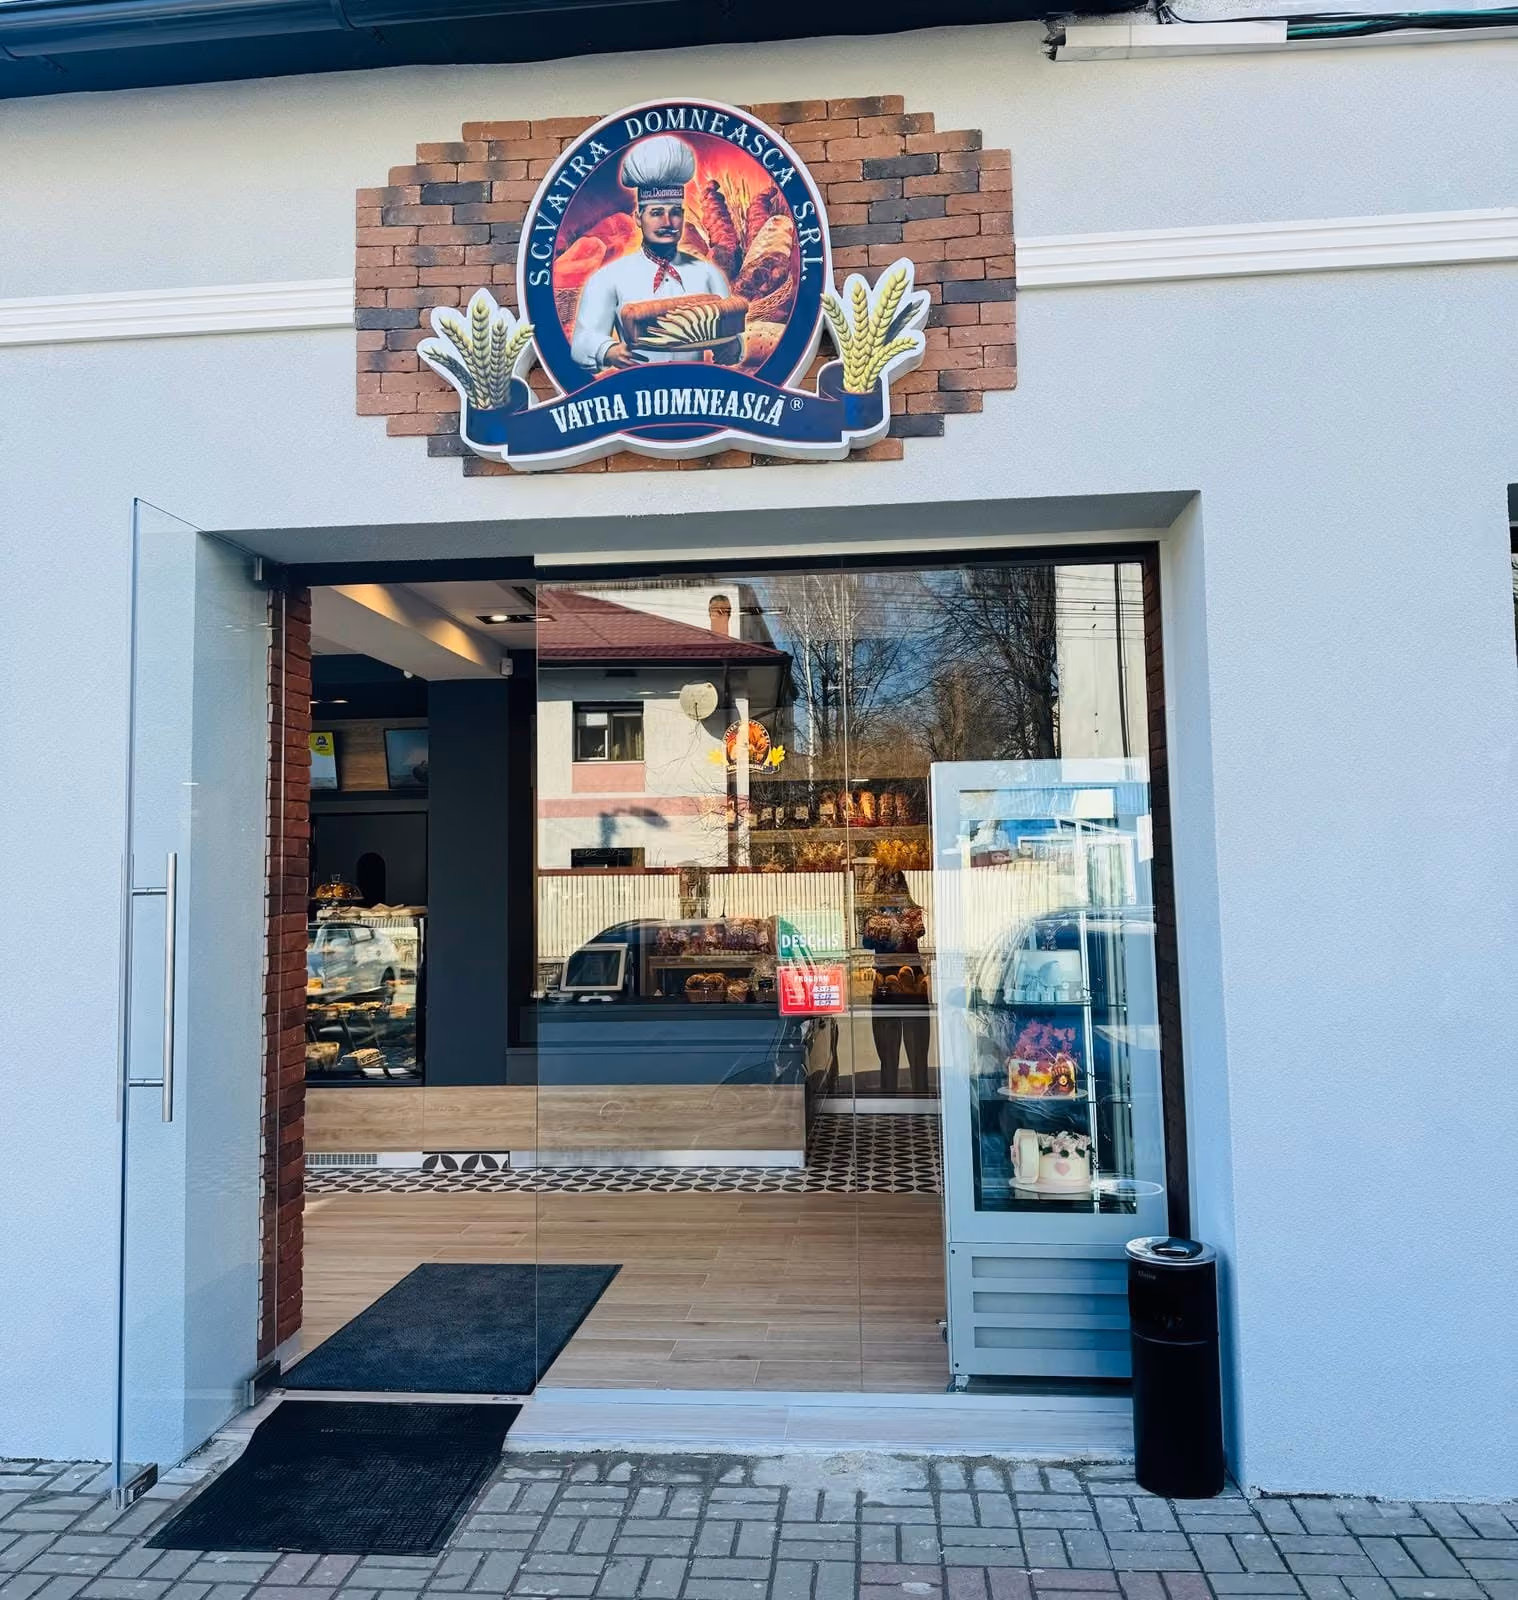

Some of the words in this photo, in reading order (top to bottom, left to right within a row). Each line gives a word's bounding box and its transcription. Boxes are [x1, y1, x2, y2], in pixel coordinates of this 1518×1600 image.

[624, 108, 797, 188] DOMNEASCA
[793, 200, 824, 281] S.R.L.
[549, 390, 629, 434] VATRA
[781, 933, 839, 948] DESCHIS
